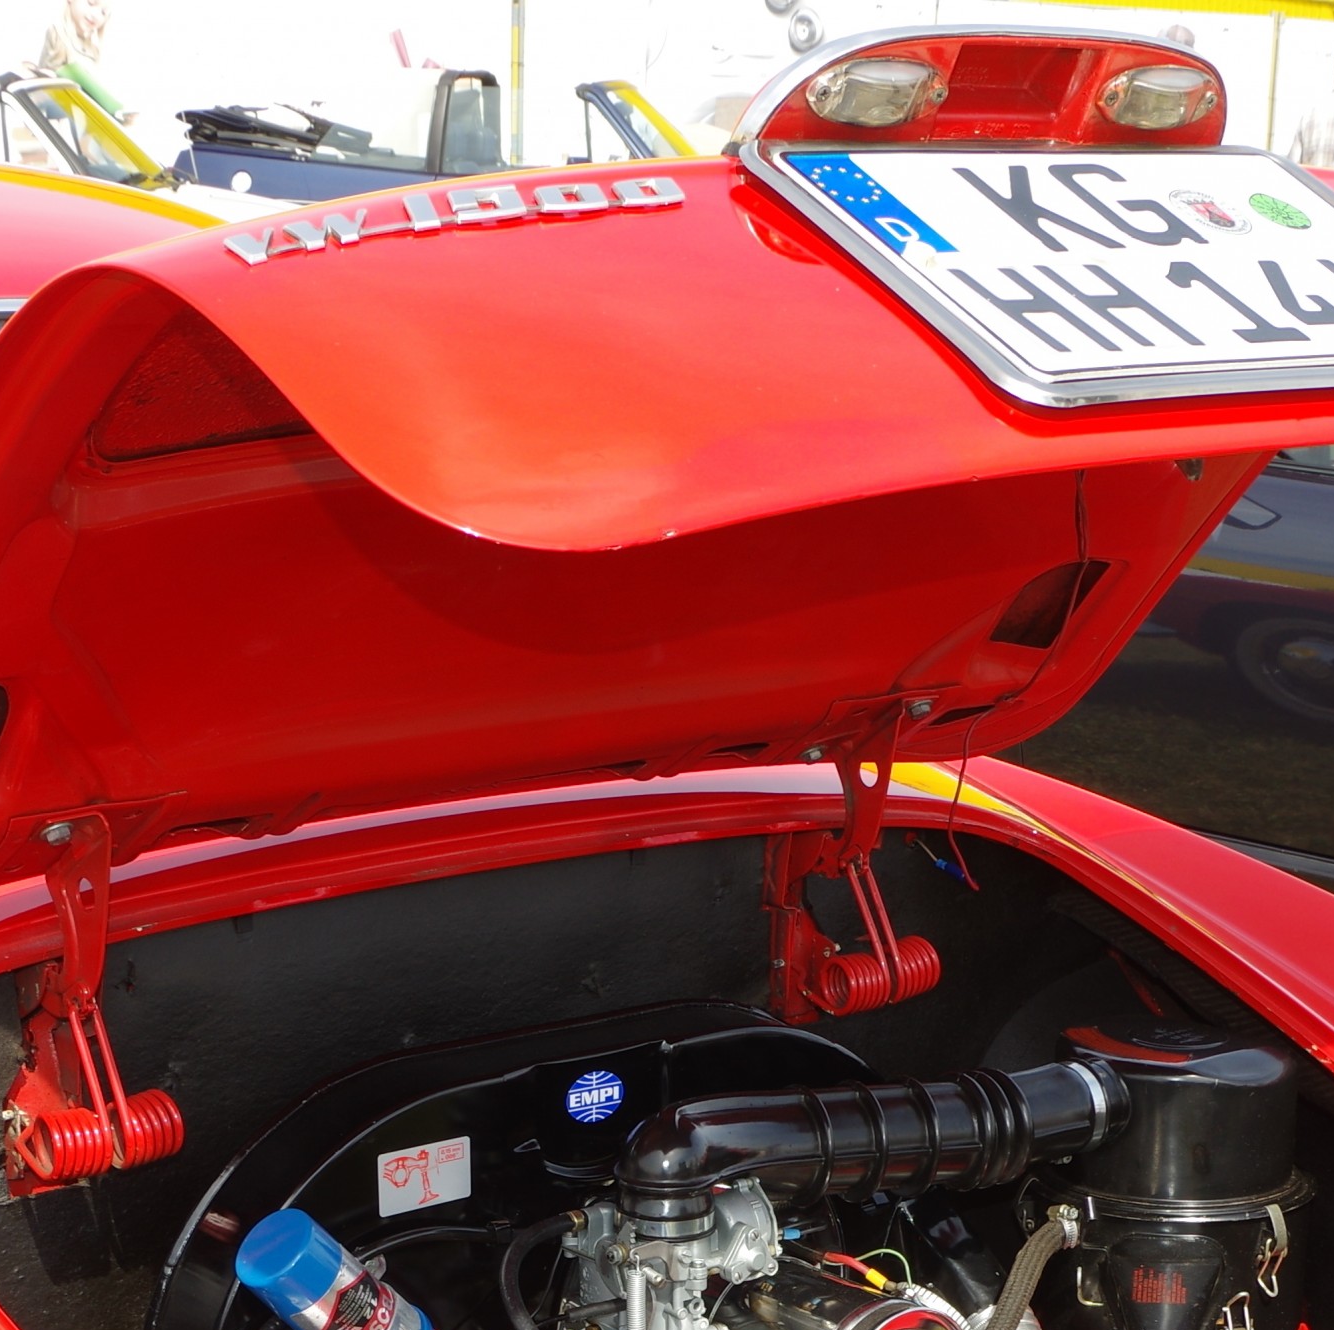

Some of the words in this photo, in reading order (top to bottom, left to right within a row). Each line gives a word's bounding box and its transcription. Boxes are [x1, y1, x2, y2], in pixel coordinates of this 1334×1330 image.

[952, 163, 1209, 252] KG
[224, 208, 367, 266] VW
[874, 217, 920, 242] D
[946, 264, 1207, 352] HH
[569, 1086, 620, 1108] EMPI
[364, 1297, 378, 1319] 12
